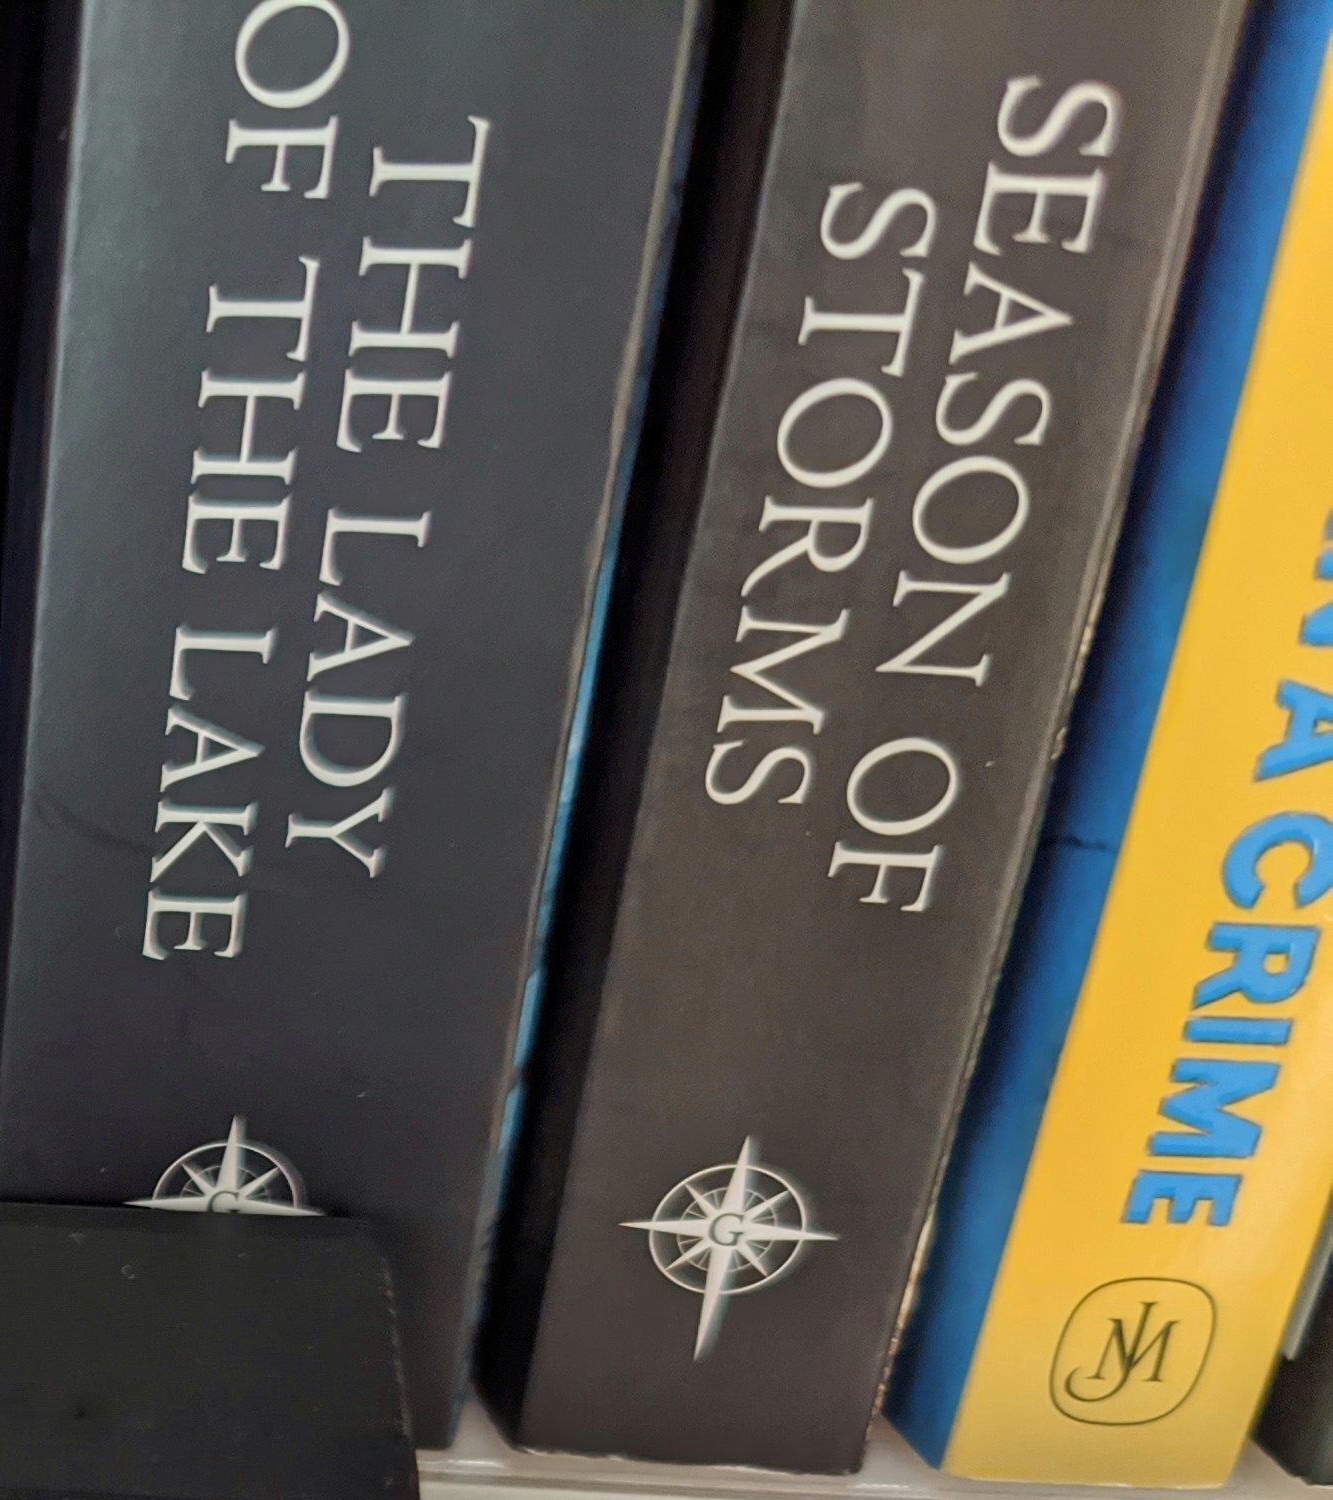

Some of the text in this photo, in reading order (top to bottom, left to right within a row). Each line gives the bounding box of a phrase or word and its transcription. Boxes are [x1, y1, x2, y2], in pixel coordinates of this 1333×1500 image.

[141, 0, 350, 961] OF THE LAKE
[284, 115, 492, 879] THE LADY
[705, 181, 937, 805] STORMS
[827, 75, 1122, 913] SEASON OF
[1119, 810, 1333, 1228] CRIME
